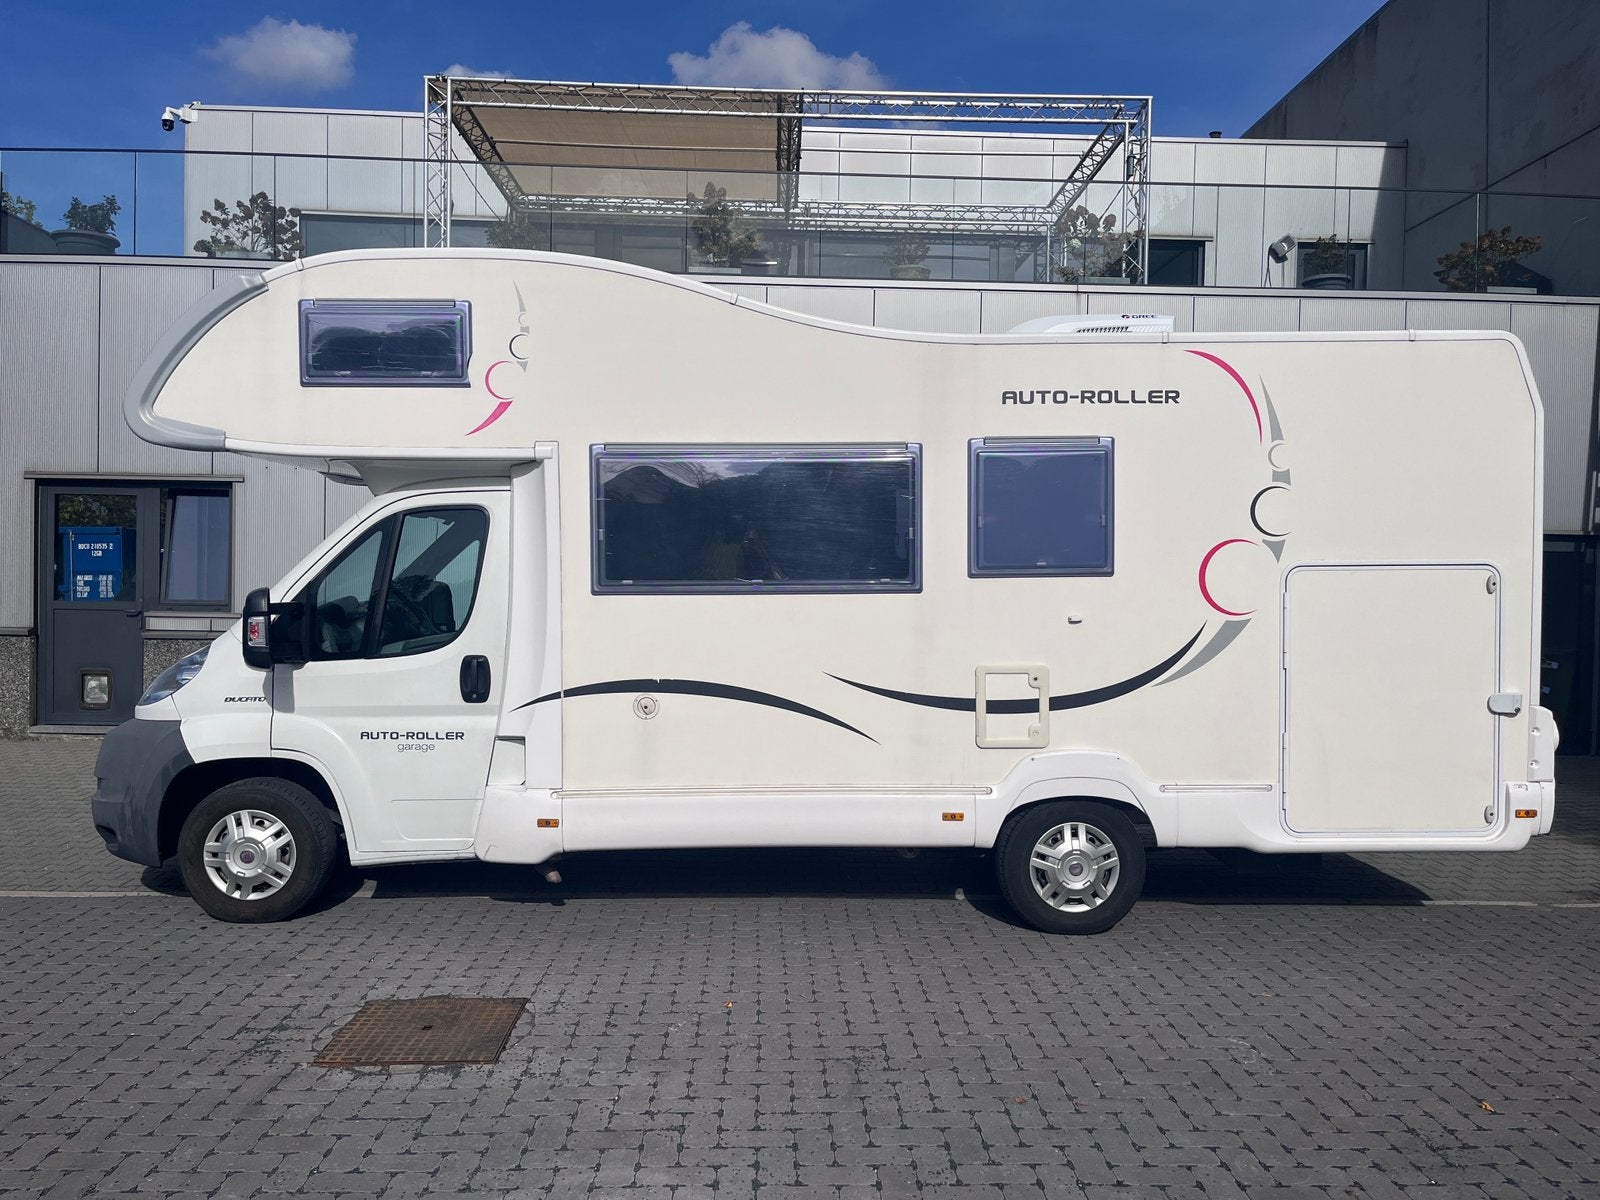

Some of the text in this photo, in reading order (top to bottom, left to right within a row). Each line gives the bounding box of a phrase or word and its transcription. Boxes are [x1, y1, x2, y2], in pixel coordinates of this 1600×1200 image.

[1002, 390, 1180, 404] AUTO-ROLLER
[360, 731, 465, 740] AUTO-ROLLER
[397, 743, 435, 753] garage
